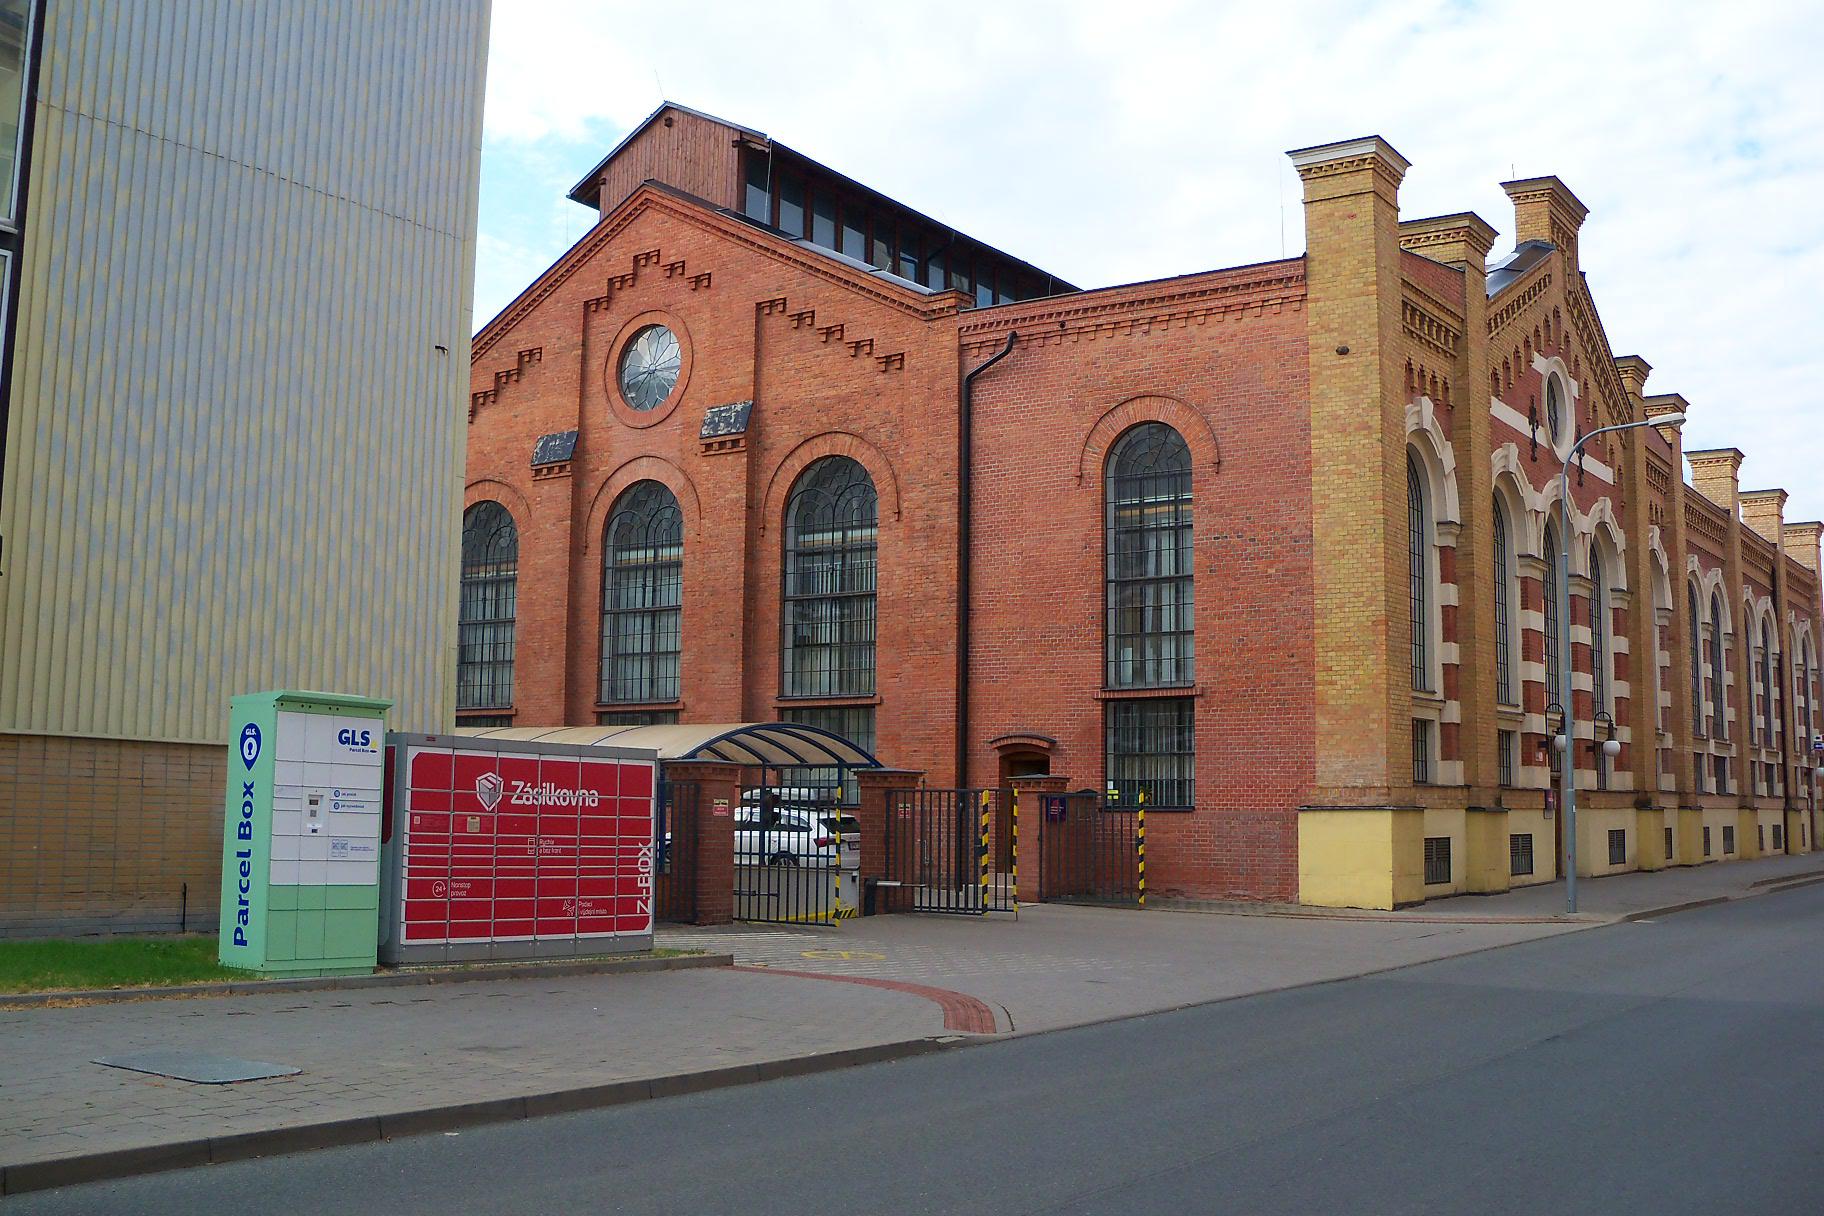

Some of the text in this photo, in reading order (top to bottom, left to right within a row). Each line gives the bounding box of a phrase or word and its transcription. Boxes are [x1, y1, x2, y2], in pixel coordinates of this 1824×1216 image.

[511, 781, 598, 807] Zásilkovna
[233, 781, 255, 947] Parcel Box
[450, 881, 472, 889] Nonstop
[637, 841, 652, 914] Z-BOX
[450, 890, 467, 898] provoz
